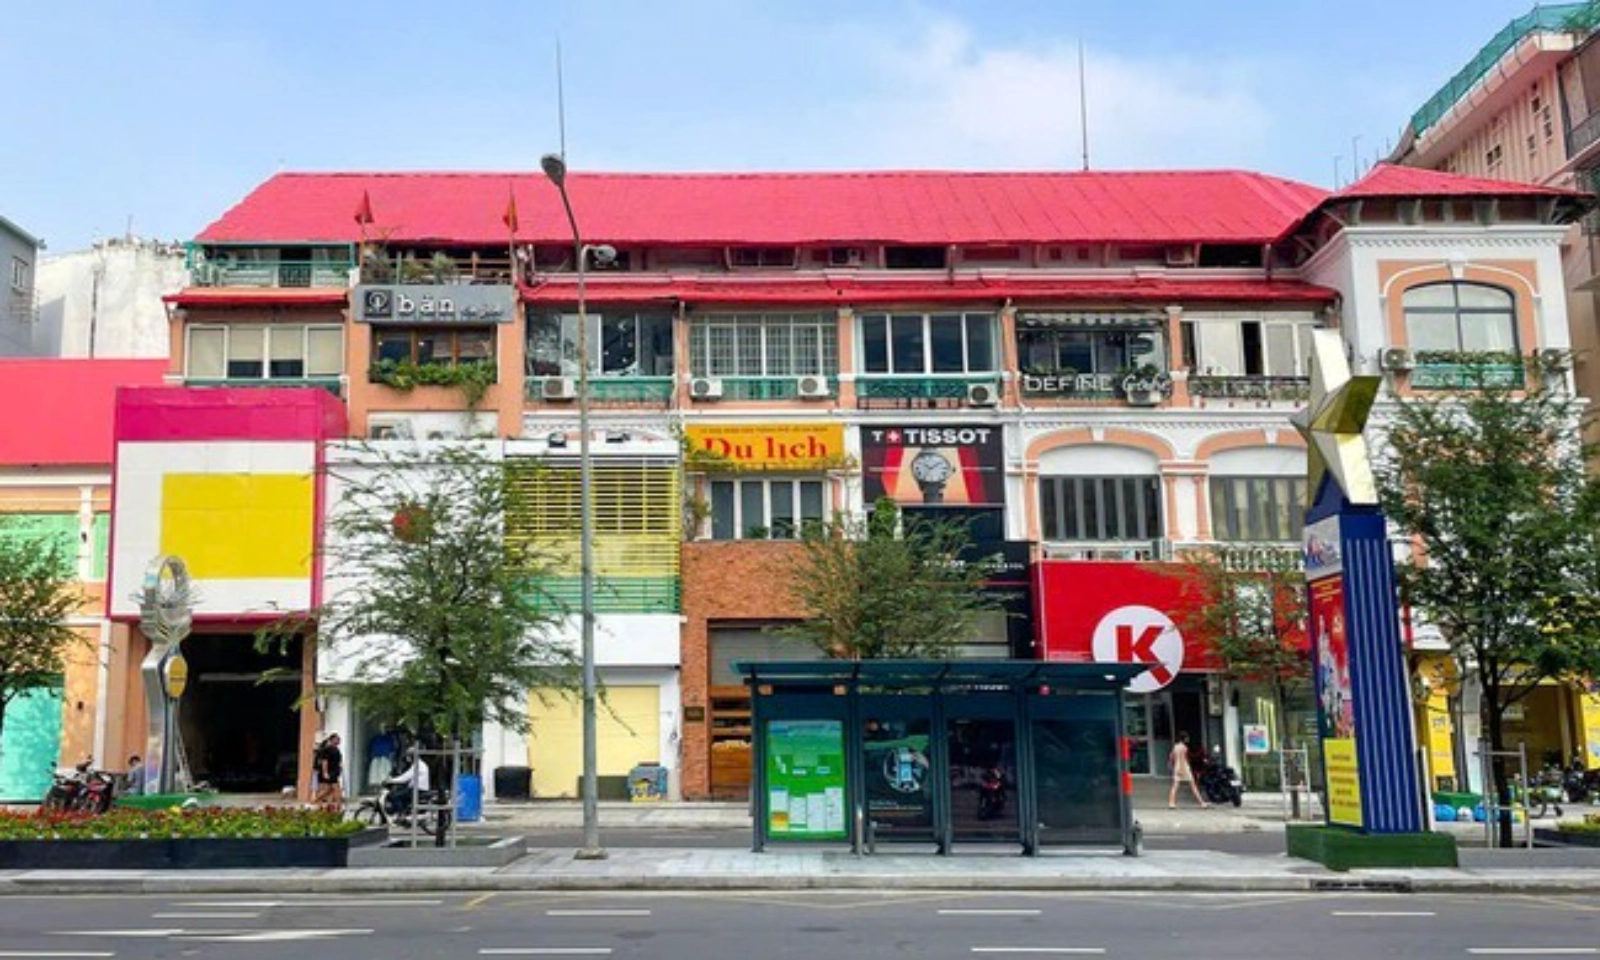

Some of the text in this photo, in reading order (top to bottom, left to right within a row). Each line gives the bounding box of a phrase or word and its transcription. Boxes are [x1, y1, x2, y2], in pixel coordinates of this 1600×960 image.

[1023, 374, 1114, 392] DEFINE
[903, 428, 991, 444] TISSOT
[704, 437, 753, 459] Du
[1115, 624, 1172, 685] K
